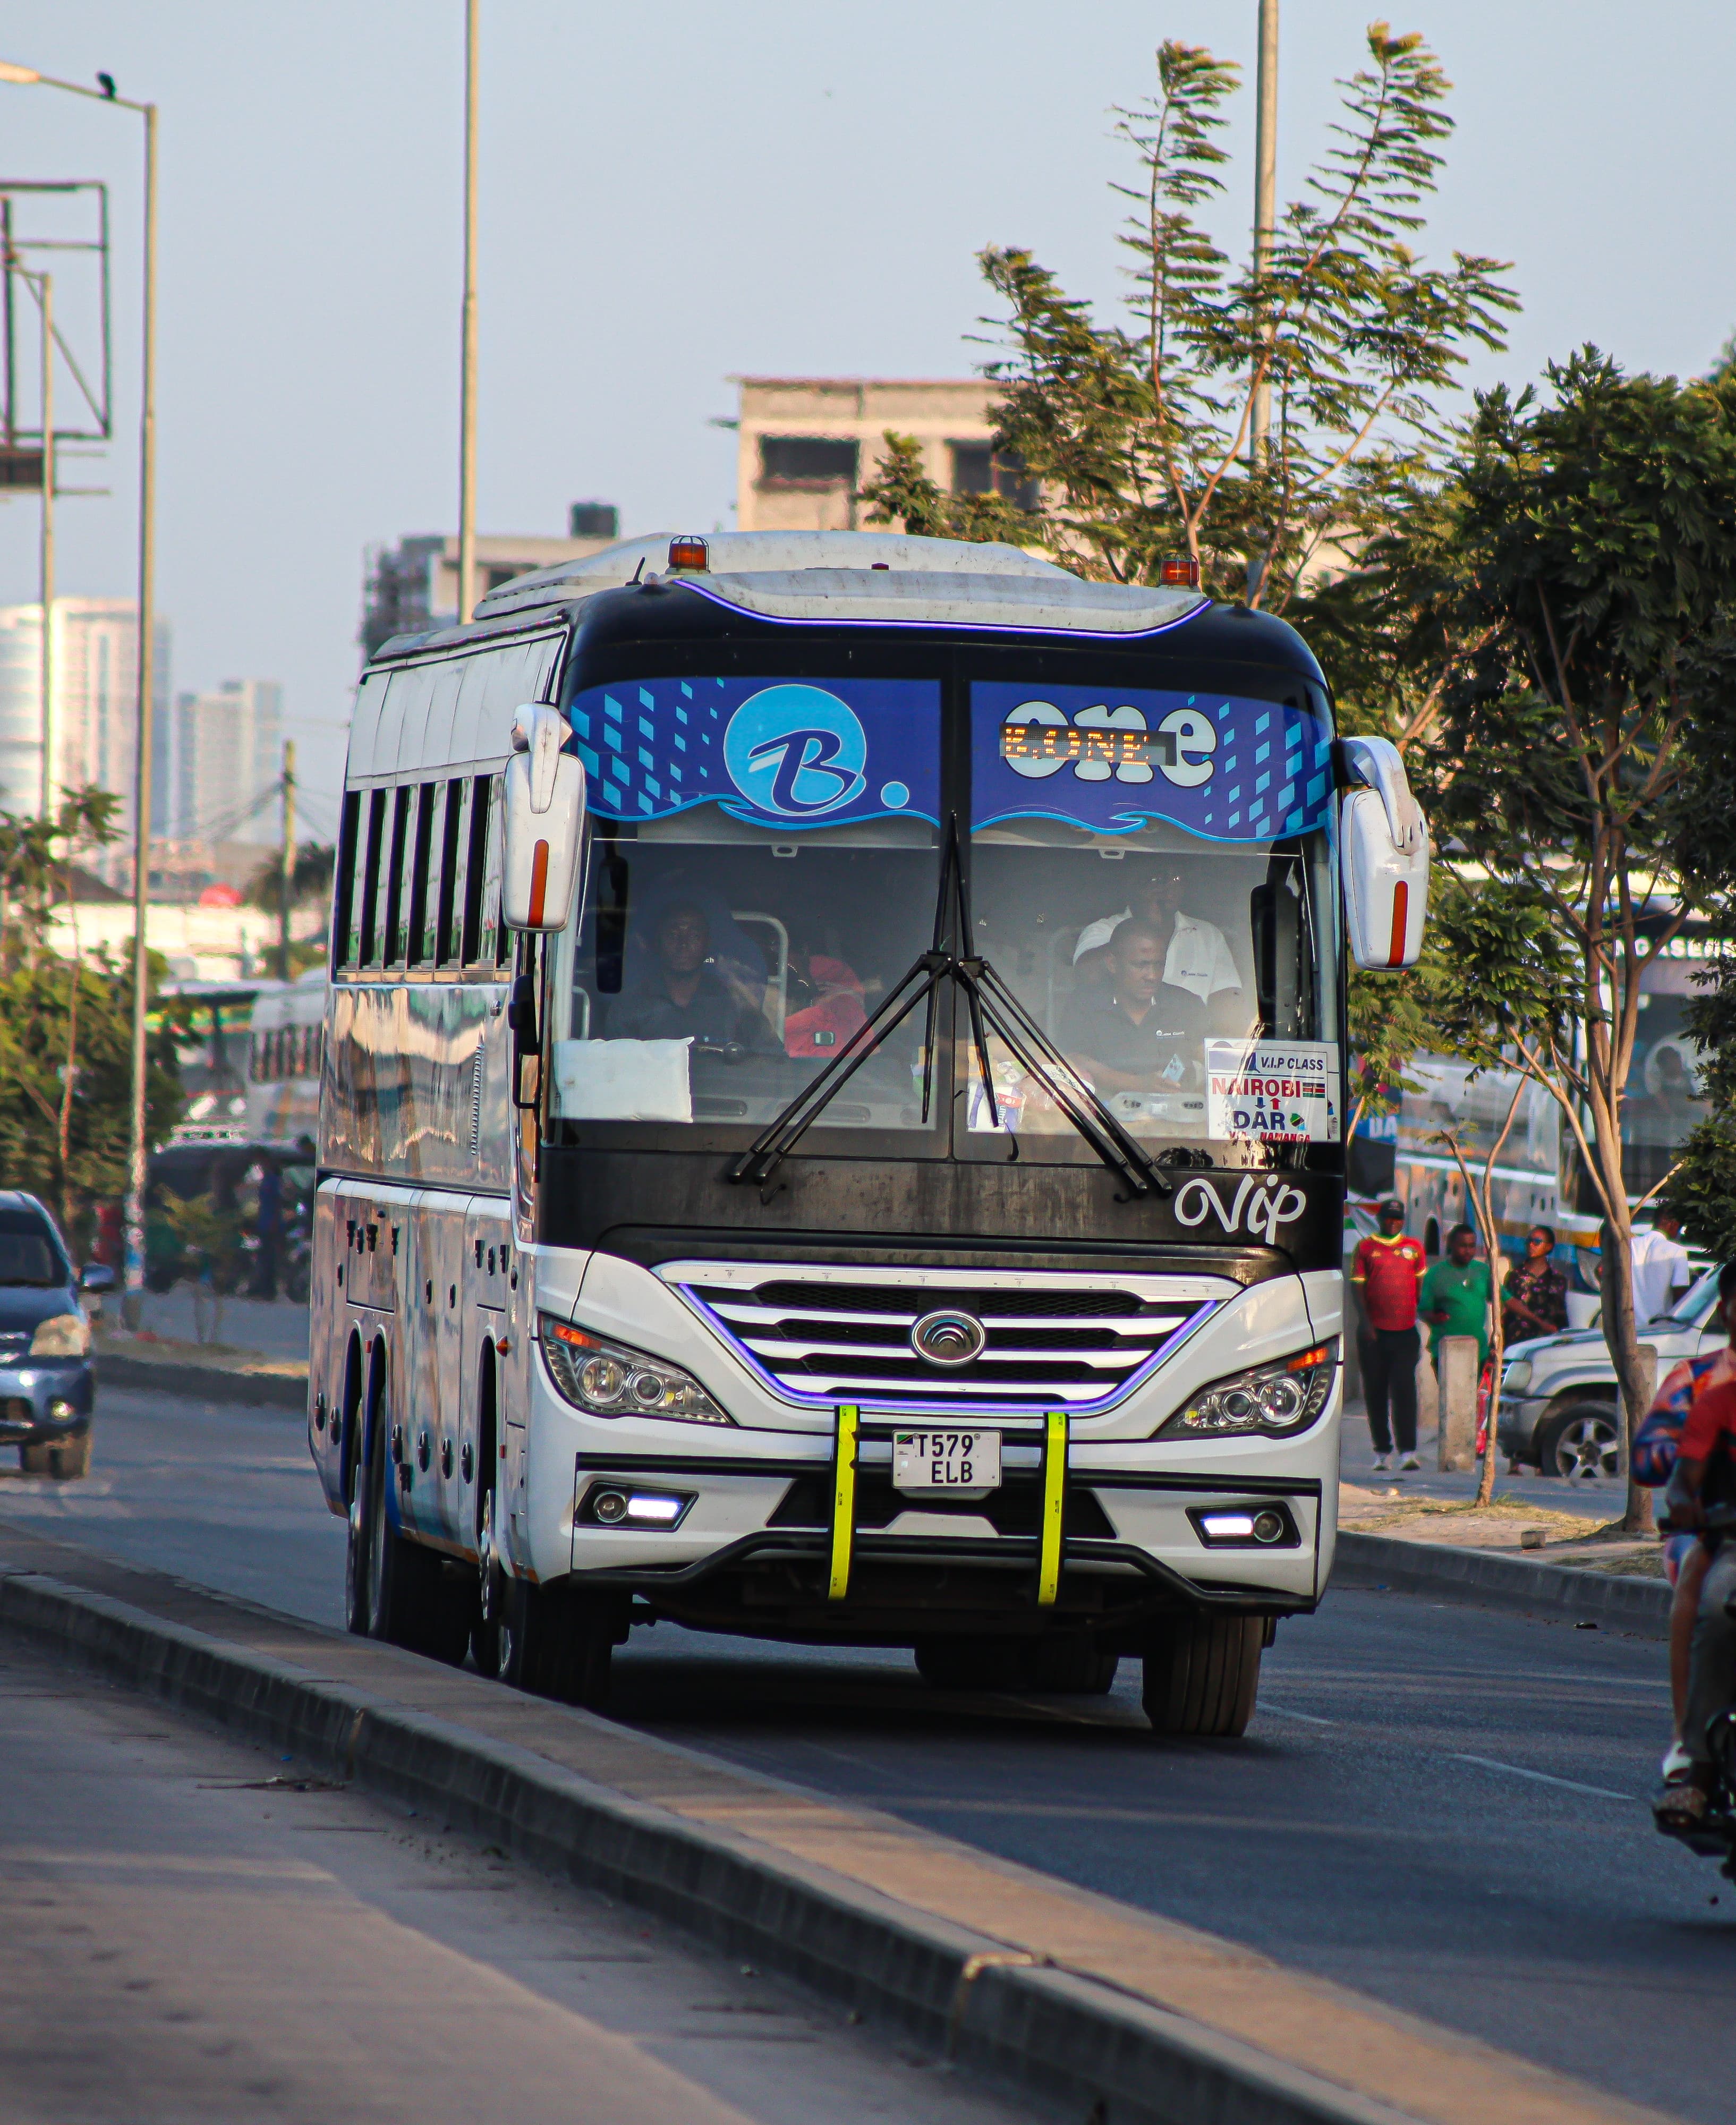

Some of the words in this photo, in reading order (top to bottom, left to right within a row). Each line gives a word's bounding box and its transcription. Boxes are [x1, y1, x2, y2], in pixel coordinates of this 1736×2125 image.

[1003, 700, 1216, 788] one
[1261, 1057, 1284, 1068] V.I.P
[1287, 1058, 1323, 1070] CLASS
[1212, 1077, 1301, 1098] NAIROBI
[1233, 1110, 1286, 1130] DAR
[1260, 1132, 1311, 1143] NAMANGA
[1175, 1174, 1306, 1245] Vip
[917, 1434, 974, 1457] T579
[931, 1461, 973, 1483] ELB
